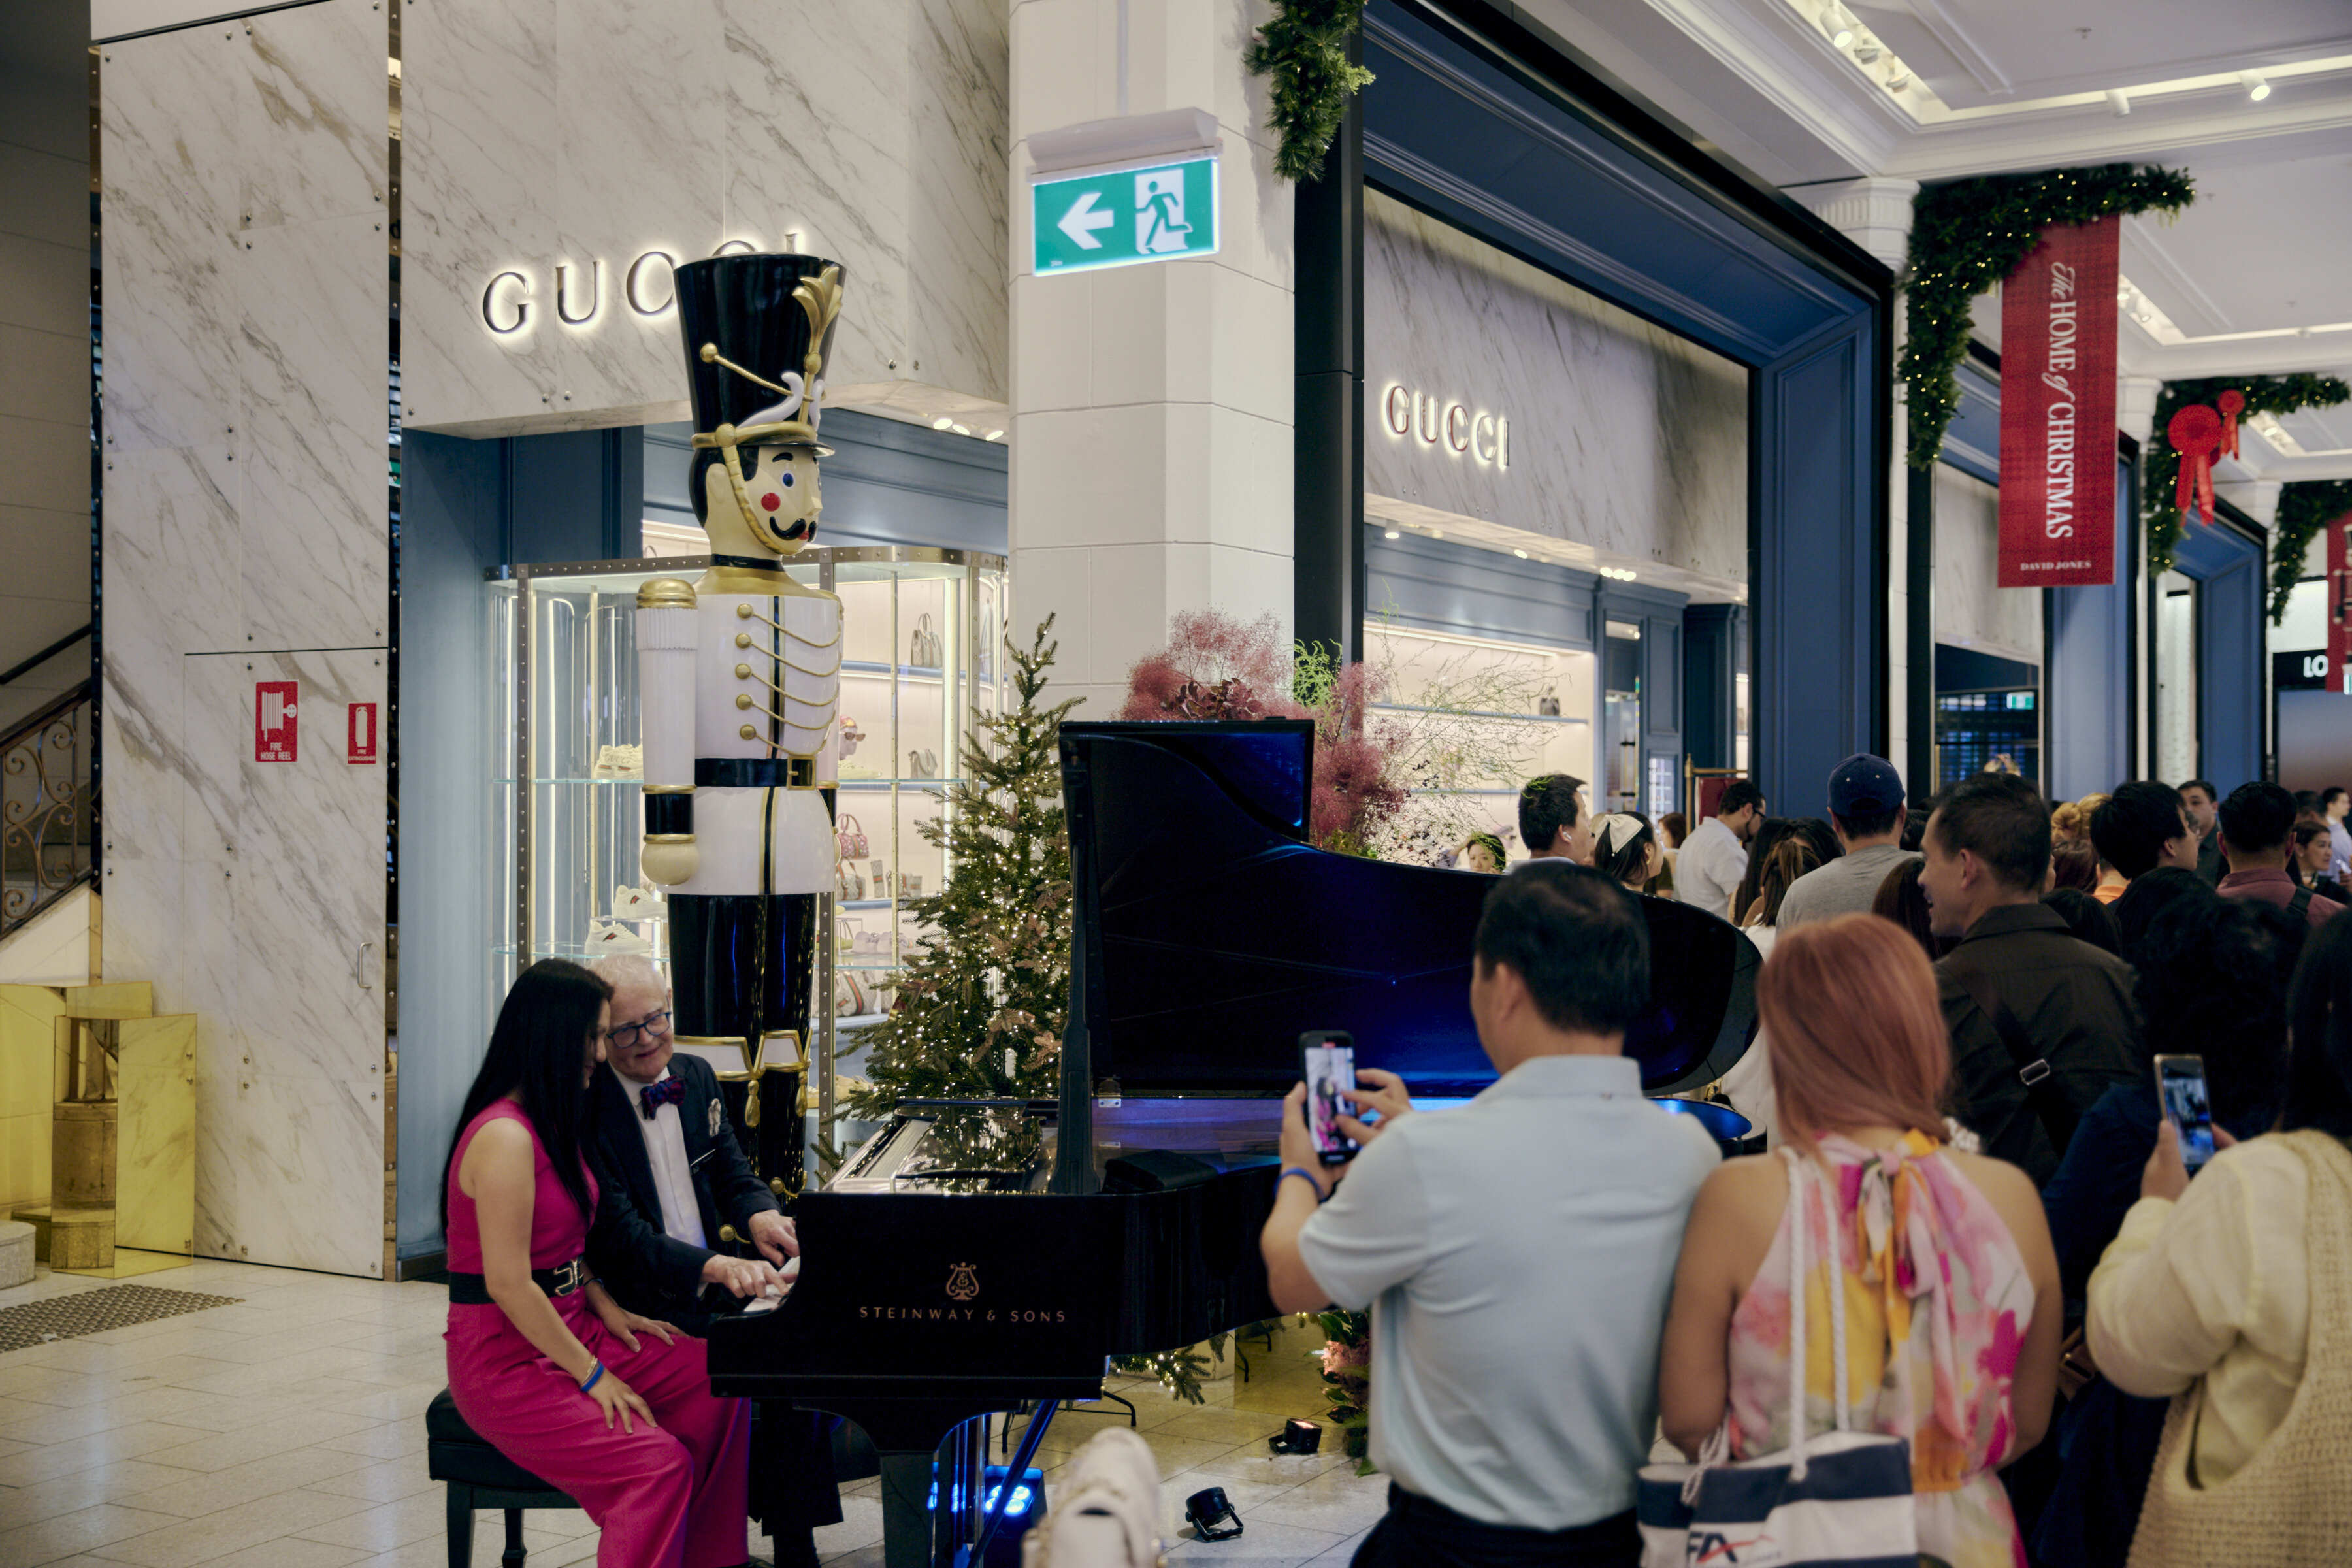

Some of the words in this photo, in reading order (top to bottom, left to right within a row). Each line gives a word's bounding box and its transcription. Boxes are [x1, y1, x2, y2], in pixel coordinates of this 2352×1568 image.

[483, 233, 798, 335] GUC
[2050, 261, 2076, 300] The
[2048, 300, 2077, 372] HOME
[2041, 372, 2076, 402] of
[1385, 385, 1510, 467] GUCCI
[2046, 402, 2076, 539] CHRISTMAS
[2020, 562, 2054, 571] DAVID
[2055, 560, 2091, 570] JONES
[260, 751, 276, 760] HOSE
[277, 751, 292, 760] REEL
[270, 742, 282, 751] FIRE
[860, 1307, 973, 1320] STEINWAY
[986, 1309, 996, 1322] &
[1010, 1310, 1066, 1322] SONS
